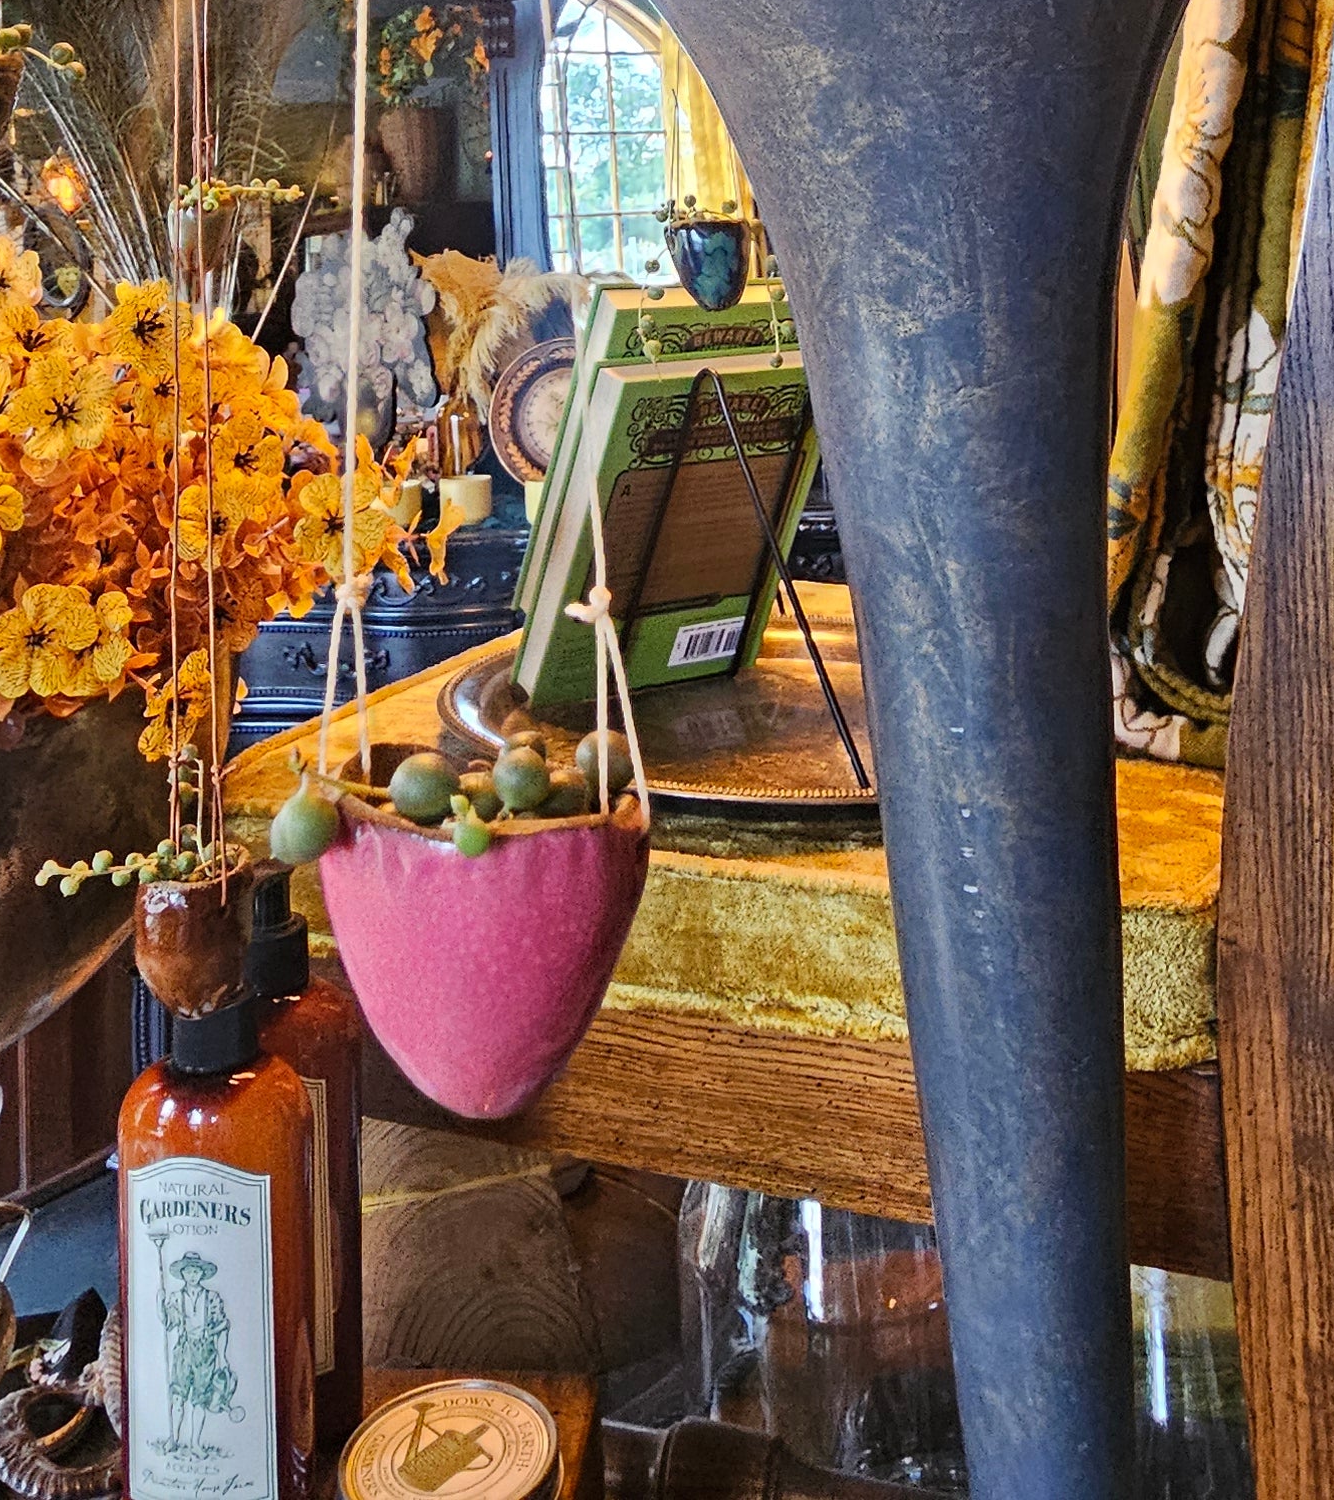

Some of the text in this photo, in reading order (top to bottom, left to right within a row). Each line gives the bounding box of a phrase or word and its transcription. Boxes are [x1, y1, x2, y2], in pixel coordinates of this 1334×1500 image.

[157, 1181, 230, 1197] NATURAL
[139, 1198, 252, 1227] GARDENERS
[166, 1222, 219, 1236] LOTION
[442, 1396, 495, 1408] DOWN
